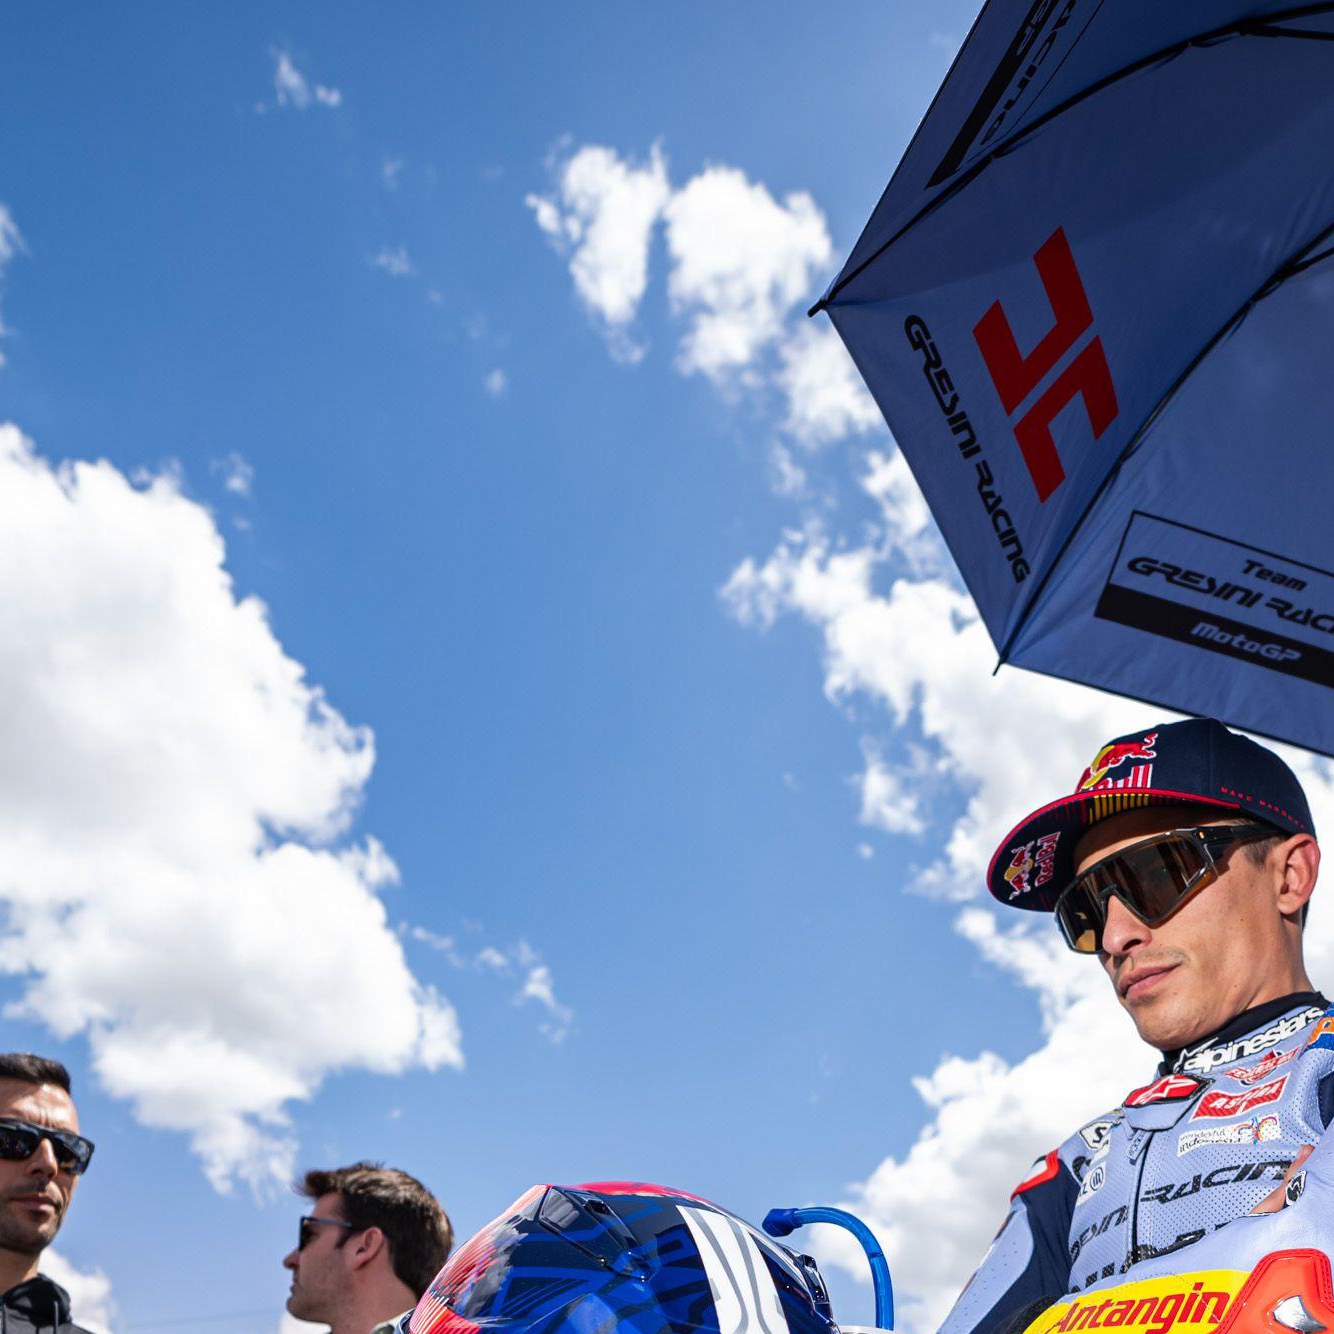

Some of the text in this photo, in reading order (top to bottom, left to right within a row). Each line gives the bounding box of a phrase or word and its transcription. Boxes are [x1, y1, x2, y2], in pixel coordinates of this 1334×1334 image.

[904, 314, 1031, 584] GRESINI RACING
[1127, 556, 1264, 609] GRESINI
[1241, 559, 1308, 592] Team
[1189, 621, 1303, 663] MotoGP
[1183, 1006, 1324, 1074] alpinestars
[1140, 1160, 1294, 1204] RACIN
